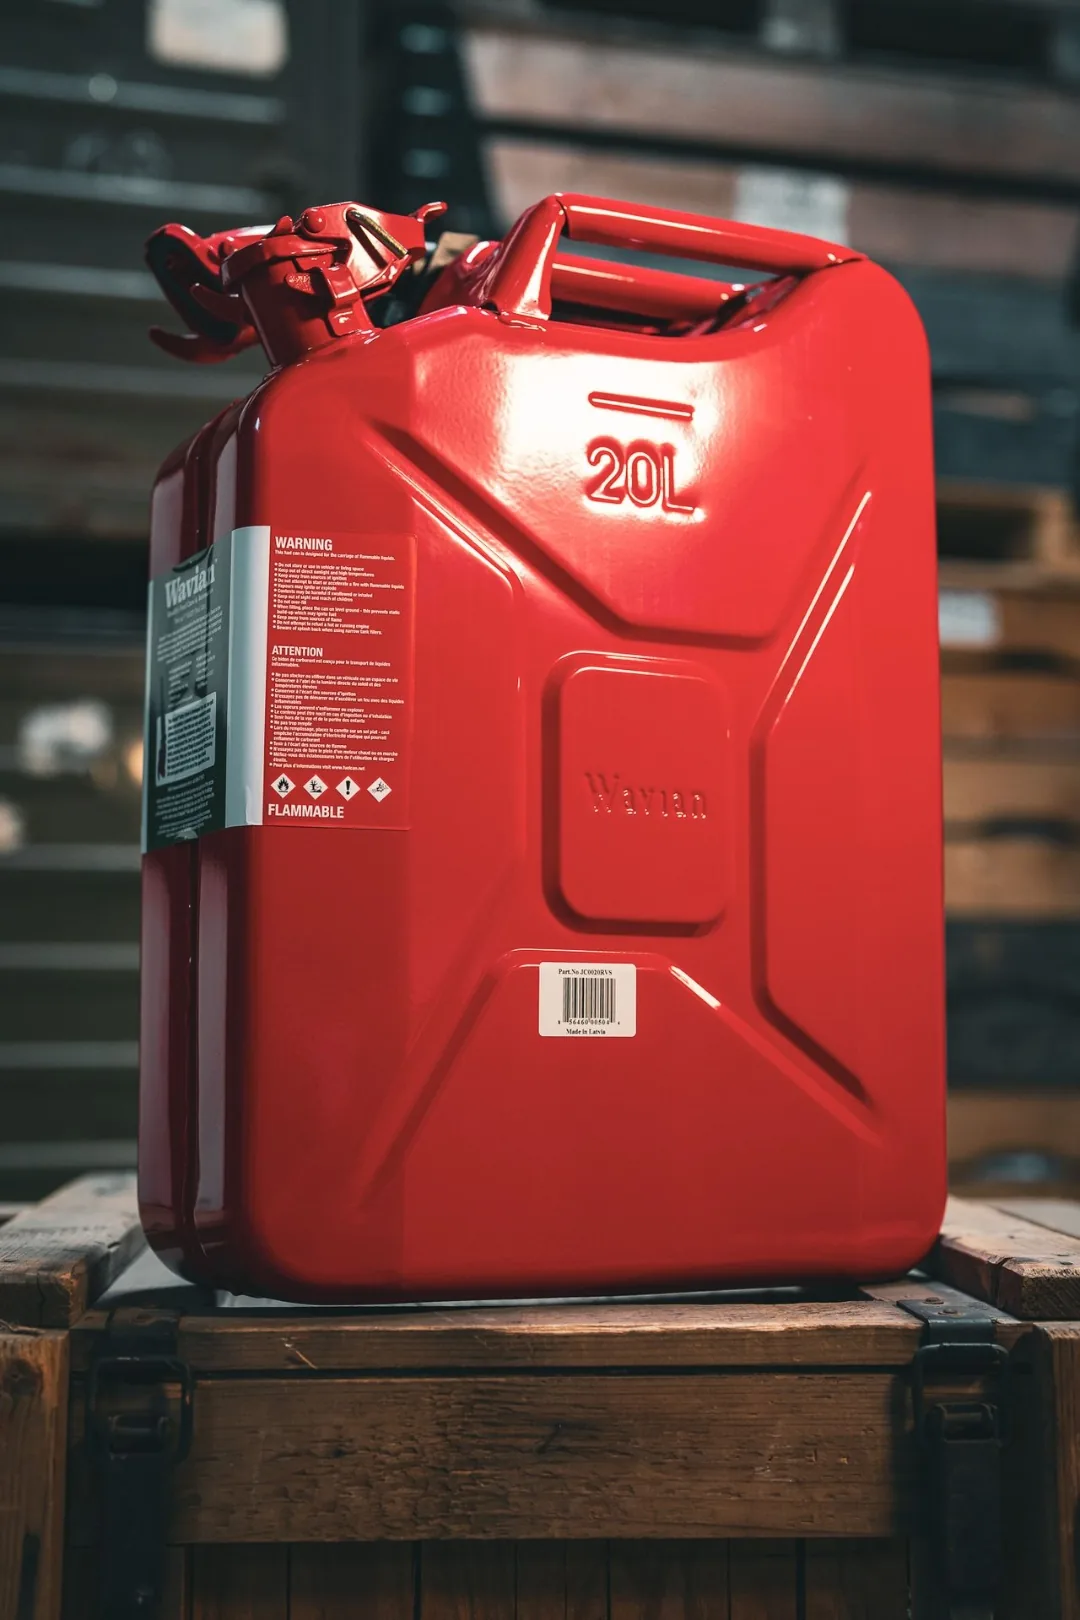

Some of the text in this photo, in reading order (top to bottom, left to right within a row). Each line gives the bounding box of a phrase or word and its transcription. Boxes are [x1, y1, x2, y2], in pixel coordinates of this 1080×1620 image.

[584, 435, 699, 515] 20L
[275, 536, 332, 551] WARNING
[165, 564, 215, 608] Wavian
[272, 646, 323, 657] ATTENTION
[584, 772, 706, 819] Wavian
[268, 804, 344, 818] FLAMMABLE
